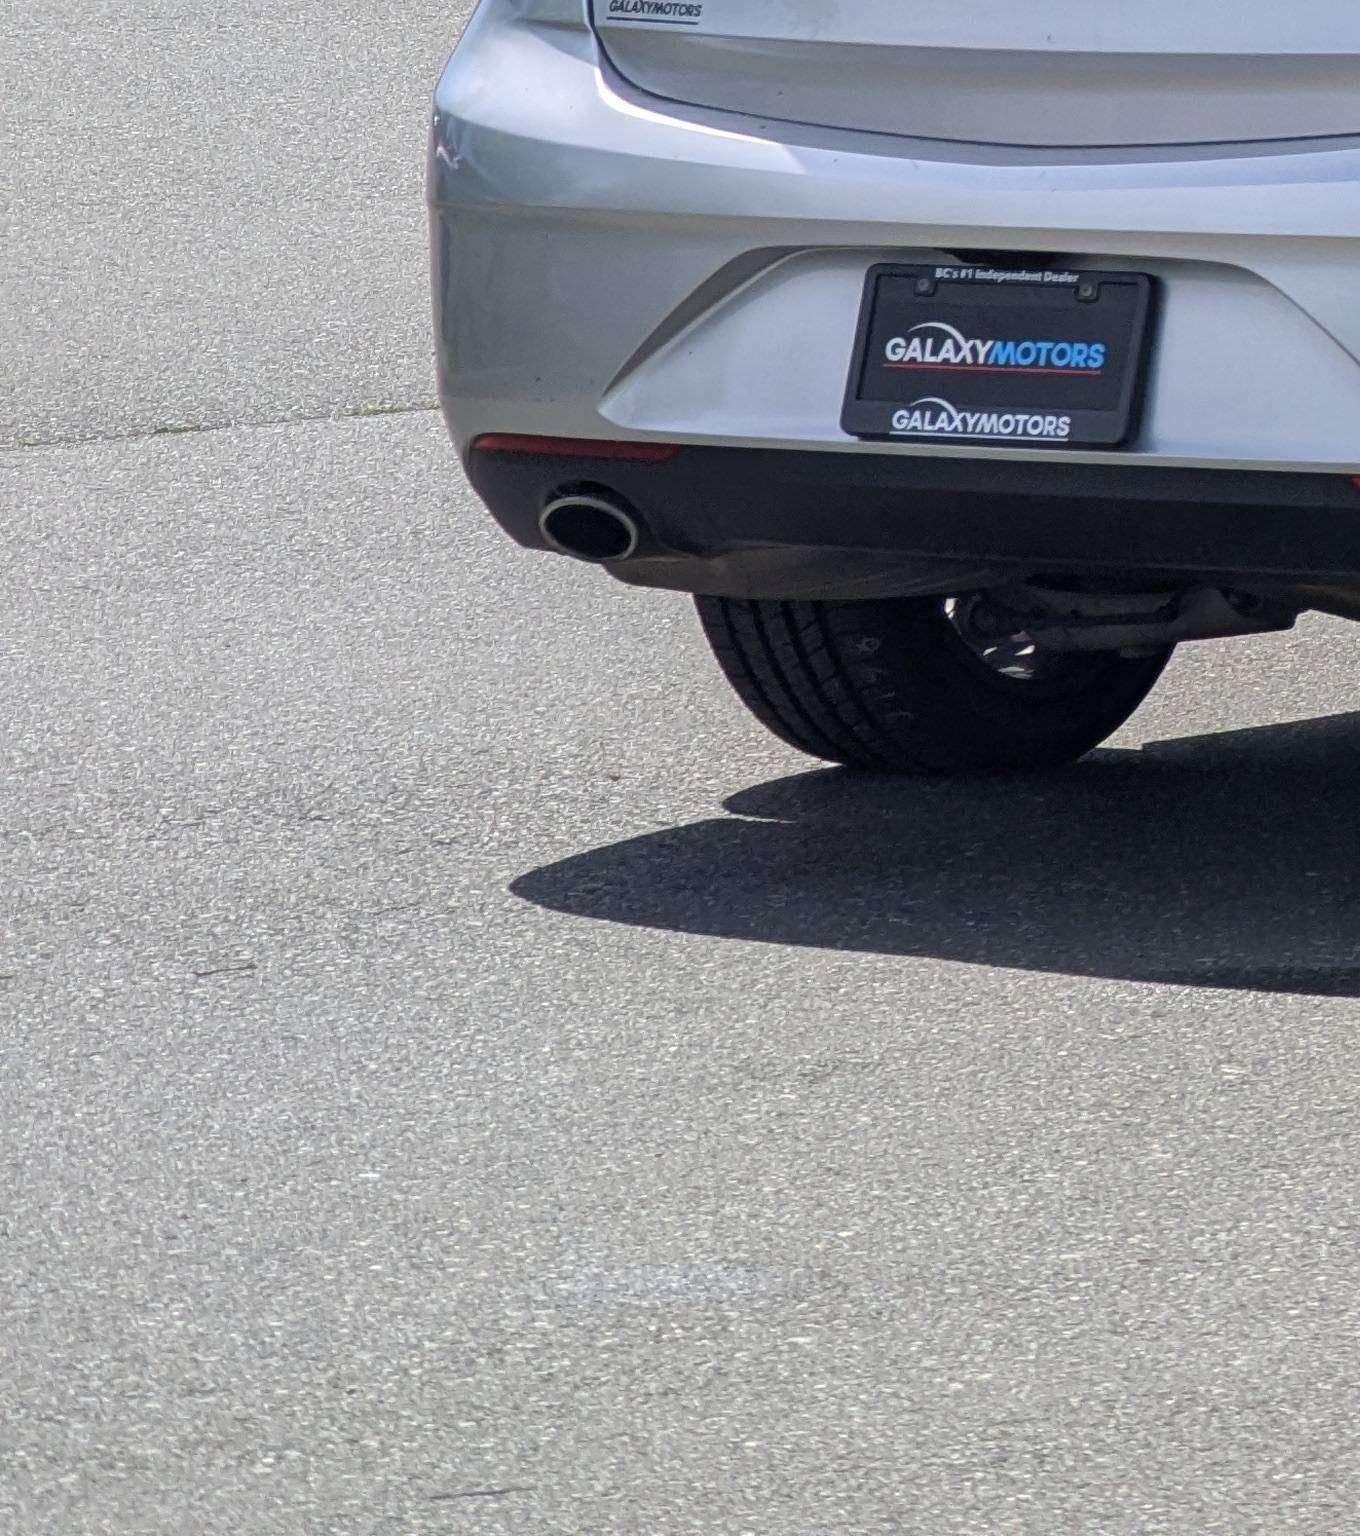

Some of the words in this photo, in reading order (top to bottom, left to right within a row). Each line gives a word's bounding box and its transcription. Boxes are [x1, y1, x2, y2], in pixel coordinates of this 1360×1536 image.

[974, 269, 1042, 283] Independent
[1043, 271, 1080, 283] Dealer
[884, 335, 1106, 369] GALAXYMOTORS
[891, 408, 1072, 437] GALAXYMOTORS
